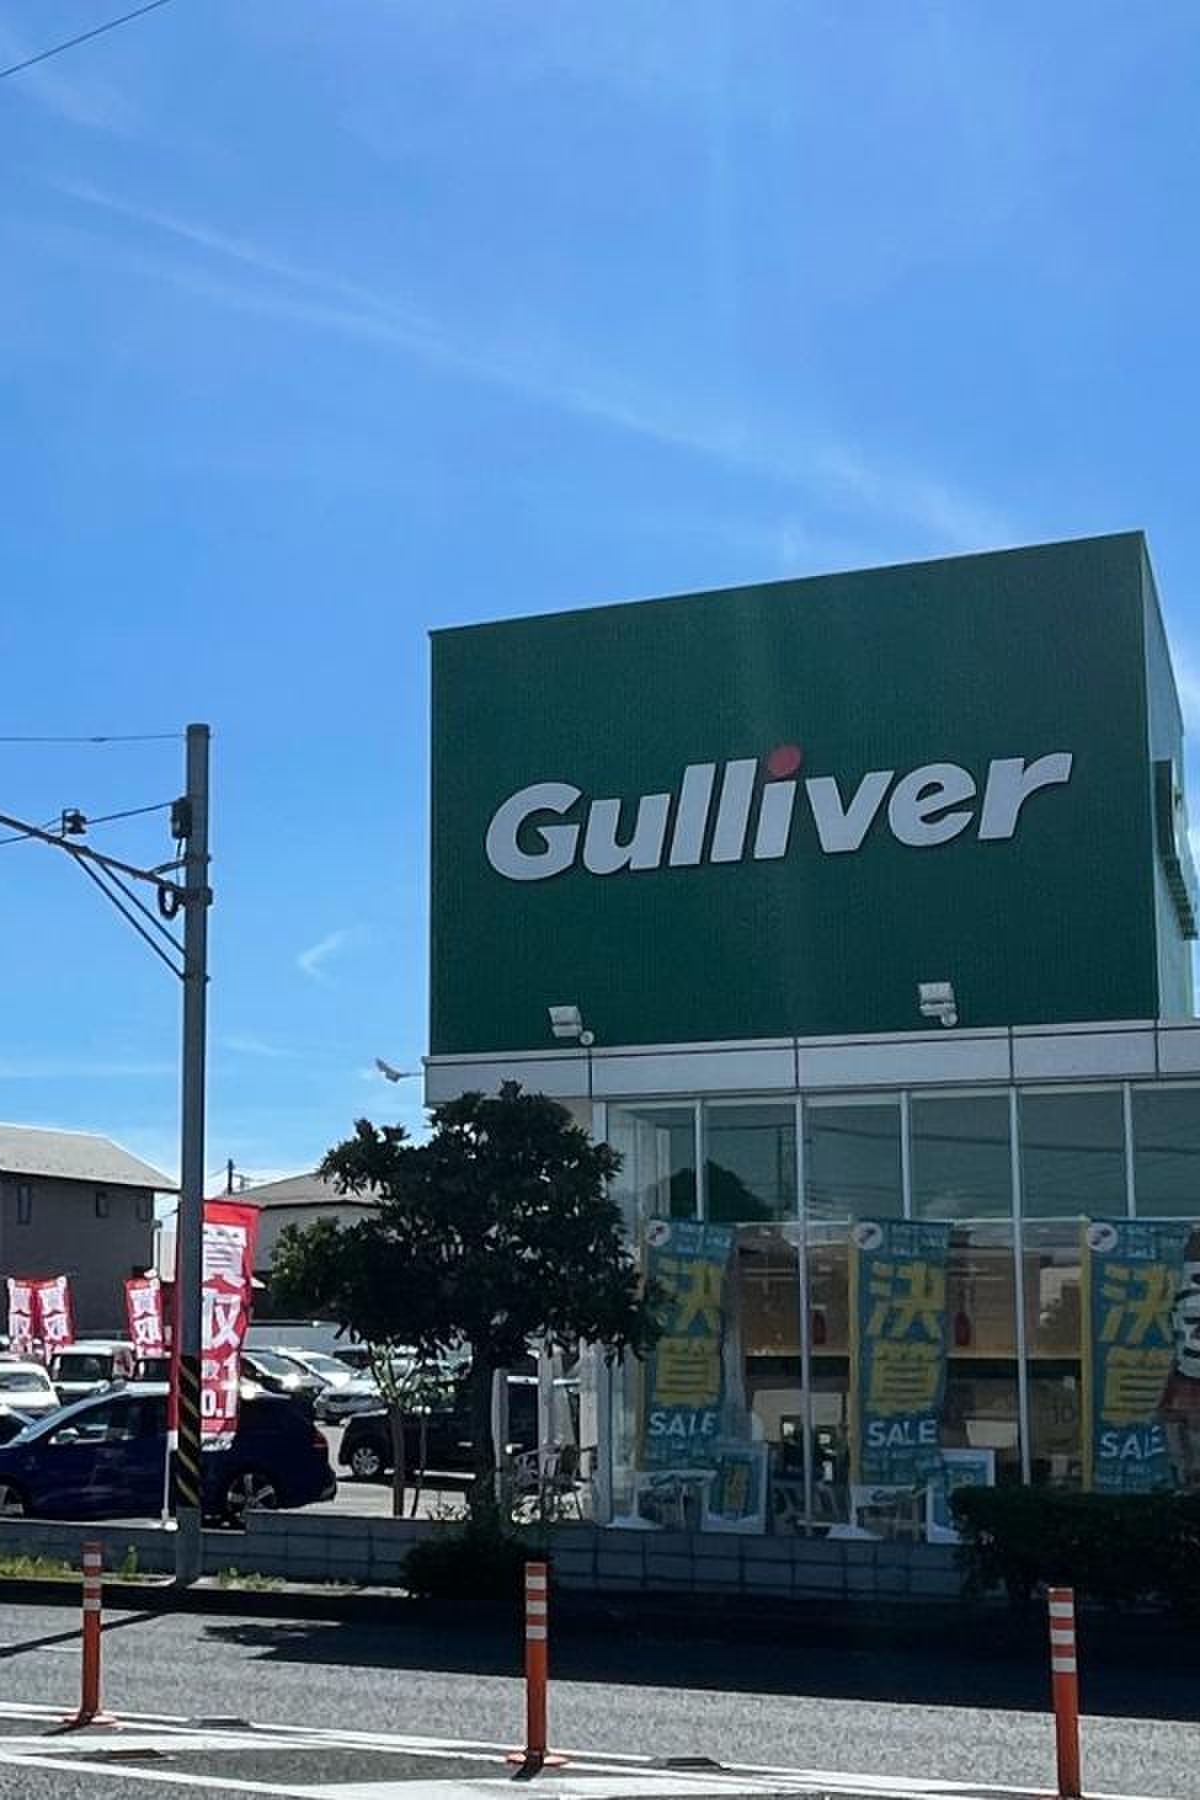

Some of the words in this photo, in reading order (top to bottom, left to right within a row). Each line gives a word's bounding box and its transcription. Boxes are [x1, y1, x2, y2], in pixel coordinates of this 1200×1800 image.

[485, 745, 1073, 881] Gulliver
[866, 1261, 944, 1417] 決算
[1103, 1263, 1176, 1424] 決算
[649, 1411, 718, 1437] SALE
[867, 1419, 938, 1446] SALE
[1101, 1424, 1167, 1460] SALE
